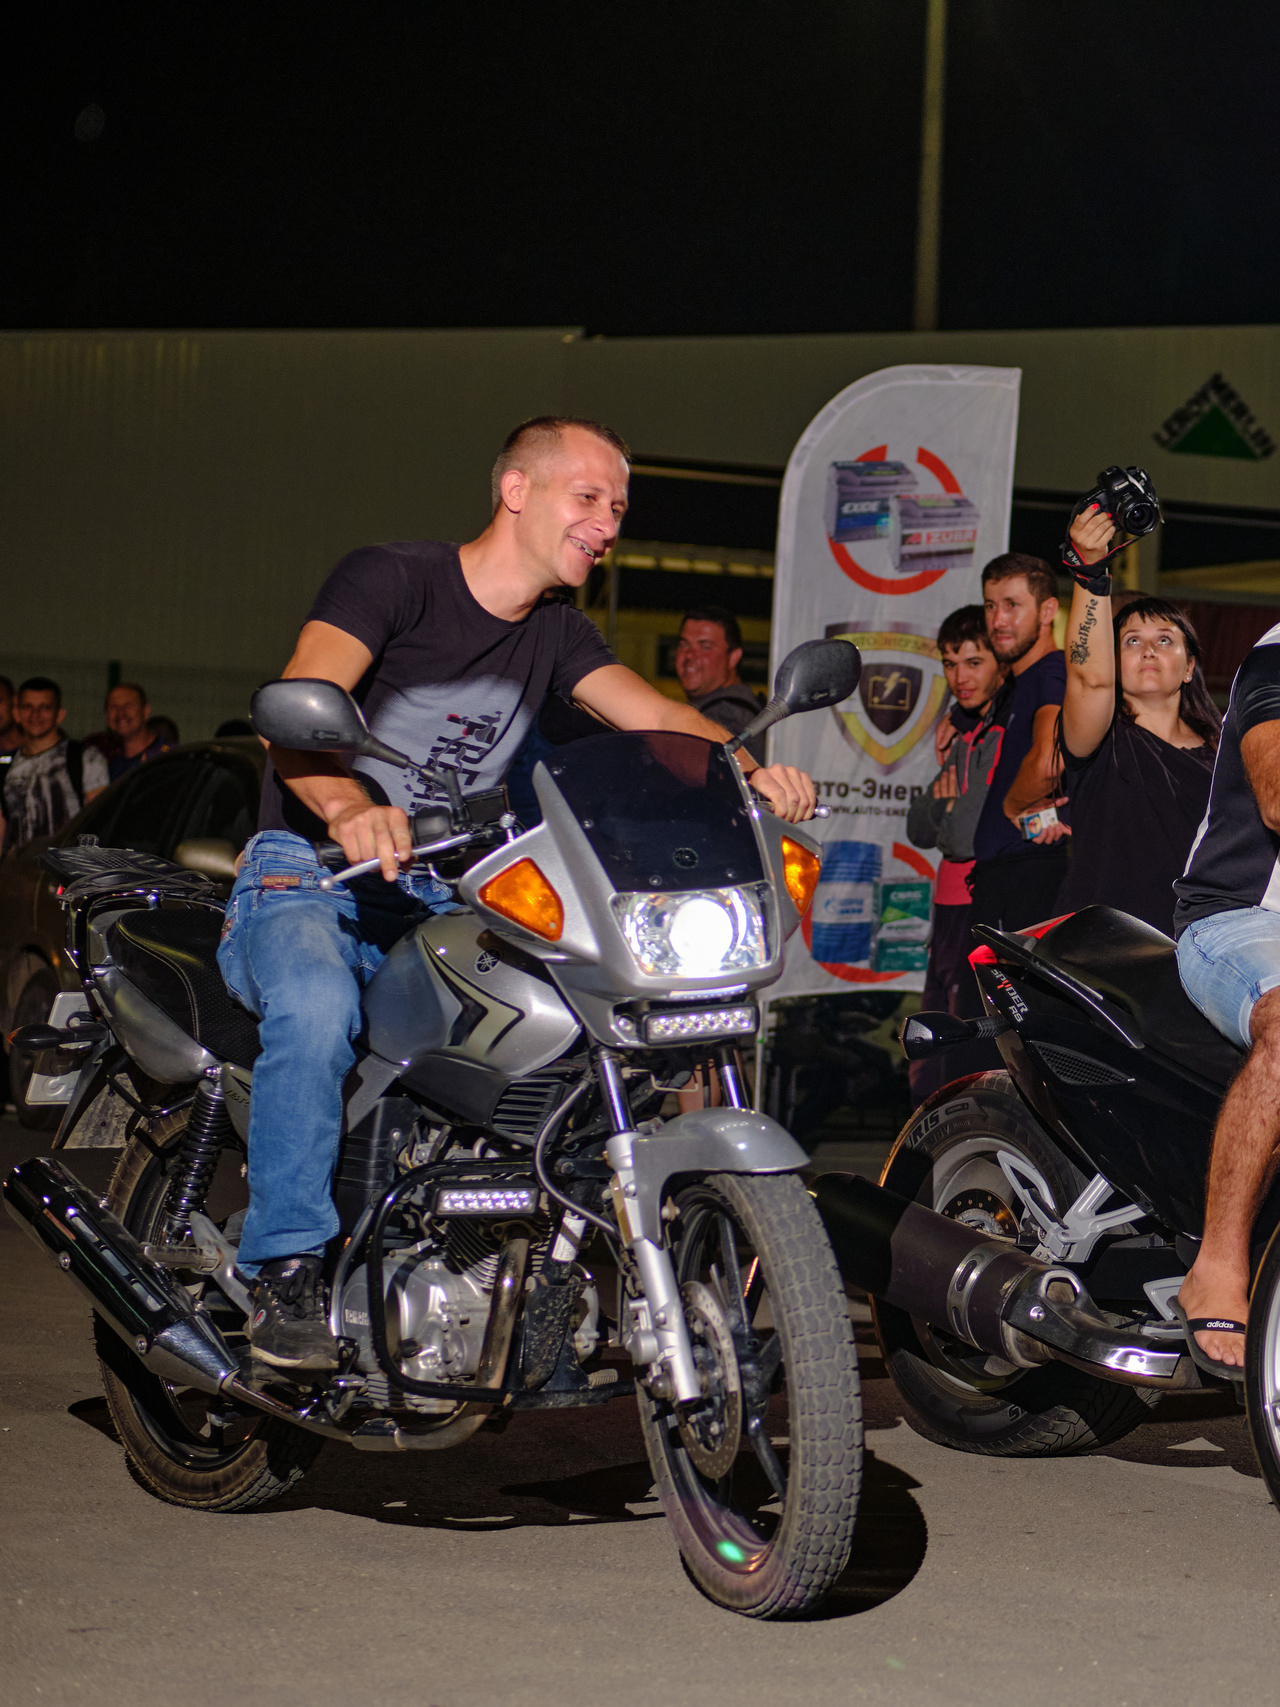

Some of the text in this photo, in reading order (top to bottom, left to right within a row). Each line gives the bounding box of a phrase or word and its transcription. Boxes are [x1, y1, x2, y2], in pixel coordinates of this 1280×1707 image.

[930, 531, 974, 542] ZUBR
[990, 968, 1030, 1014] SPYDER
[1206, 1320, 1235, 1329] adidas
